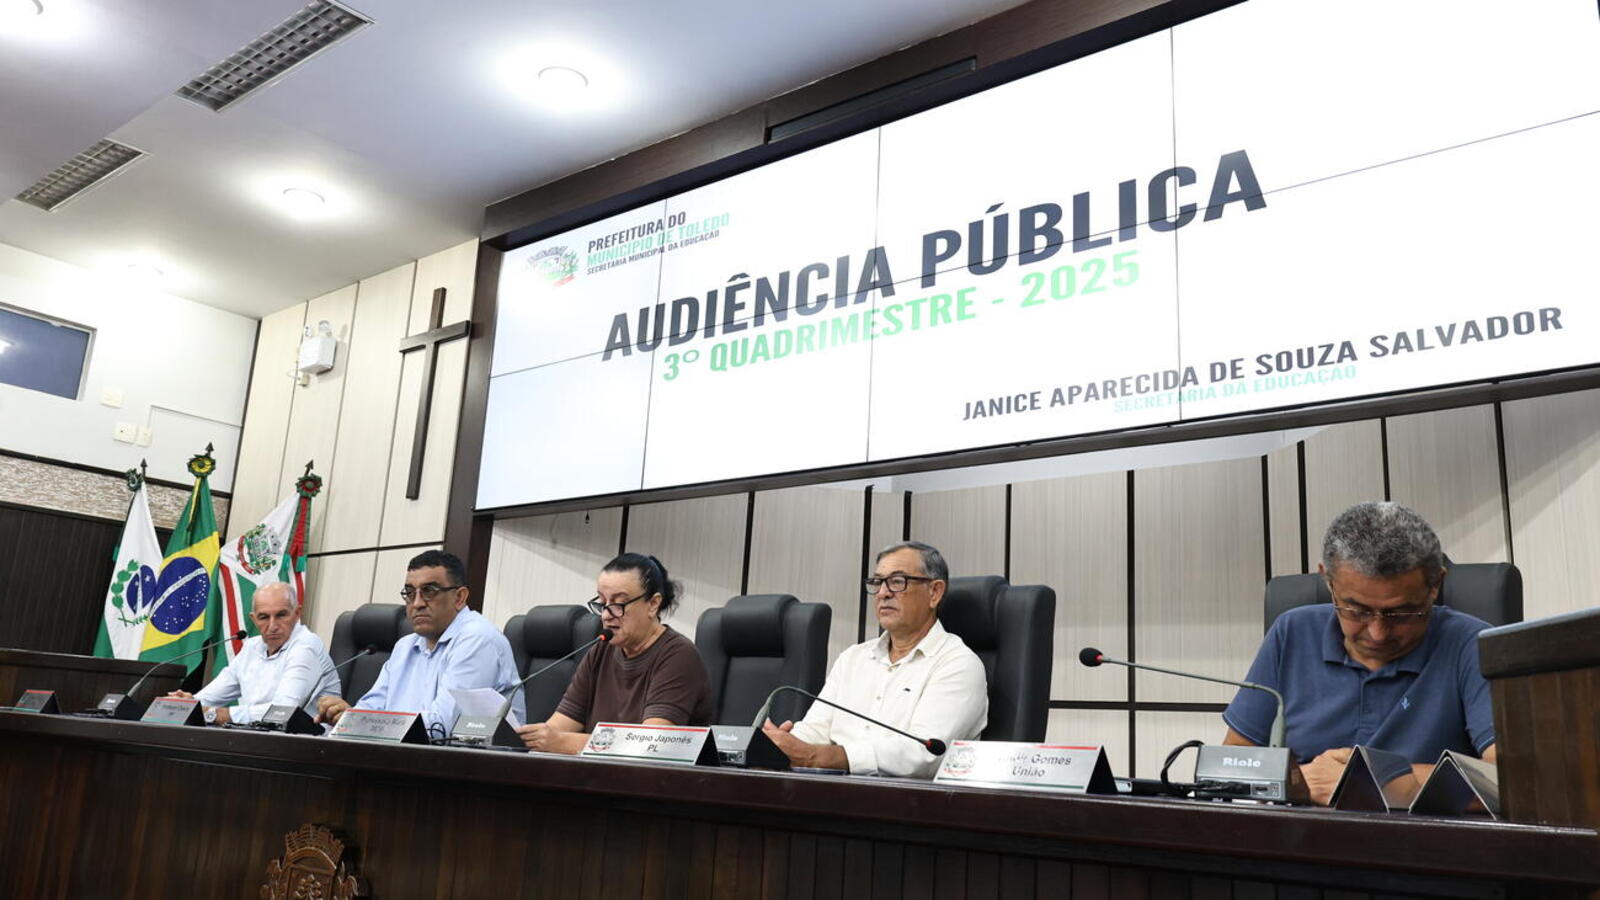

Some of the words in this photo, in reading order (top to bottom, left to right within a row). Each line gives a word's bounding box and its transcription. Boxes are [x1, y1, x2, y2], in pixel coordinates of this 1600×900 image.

[588, 219, 664, 253] PREFEITURA
[668, 211, 686, 228] DO
[657, 230, 674, 246] DE
[678, 212, 730, 239] TOLEDO
[587, 258, 627, 275] SECRETARIA
[668, 242, 678, 252] DA
[601, 245, 896, 362] AUDIÊNCIA
[921, 149, 1267, 289] PÚBLICA
[710, 286, 977, 371] QUADRIMESTRE
[1020, 249, 1140, 307] 2025
[963, 391, 1041, 421] JANICE
[1050, 366, 1199, 408] APARECIDA
[1209, 358, 1245, 383] DE
[1255, 340, 1358, 376] SOUZA
[1369, 306, 1563, 358] SALVADOR
[1223, 382, 1247, 397] DA
[647, 744, 658, 752] PL
[1031, 754, 1072, 766] Gomes
[1222, 756, 1261, 769] Riole
